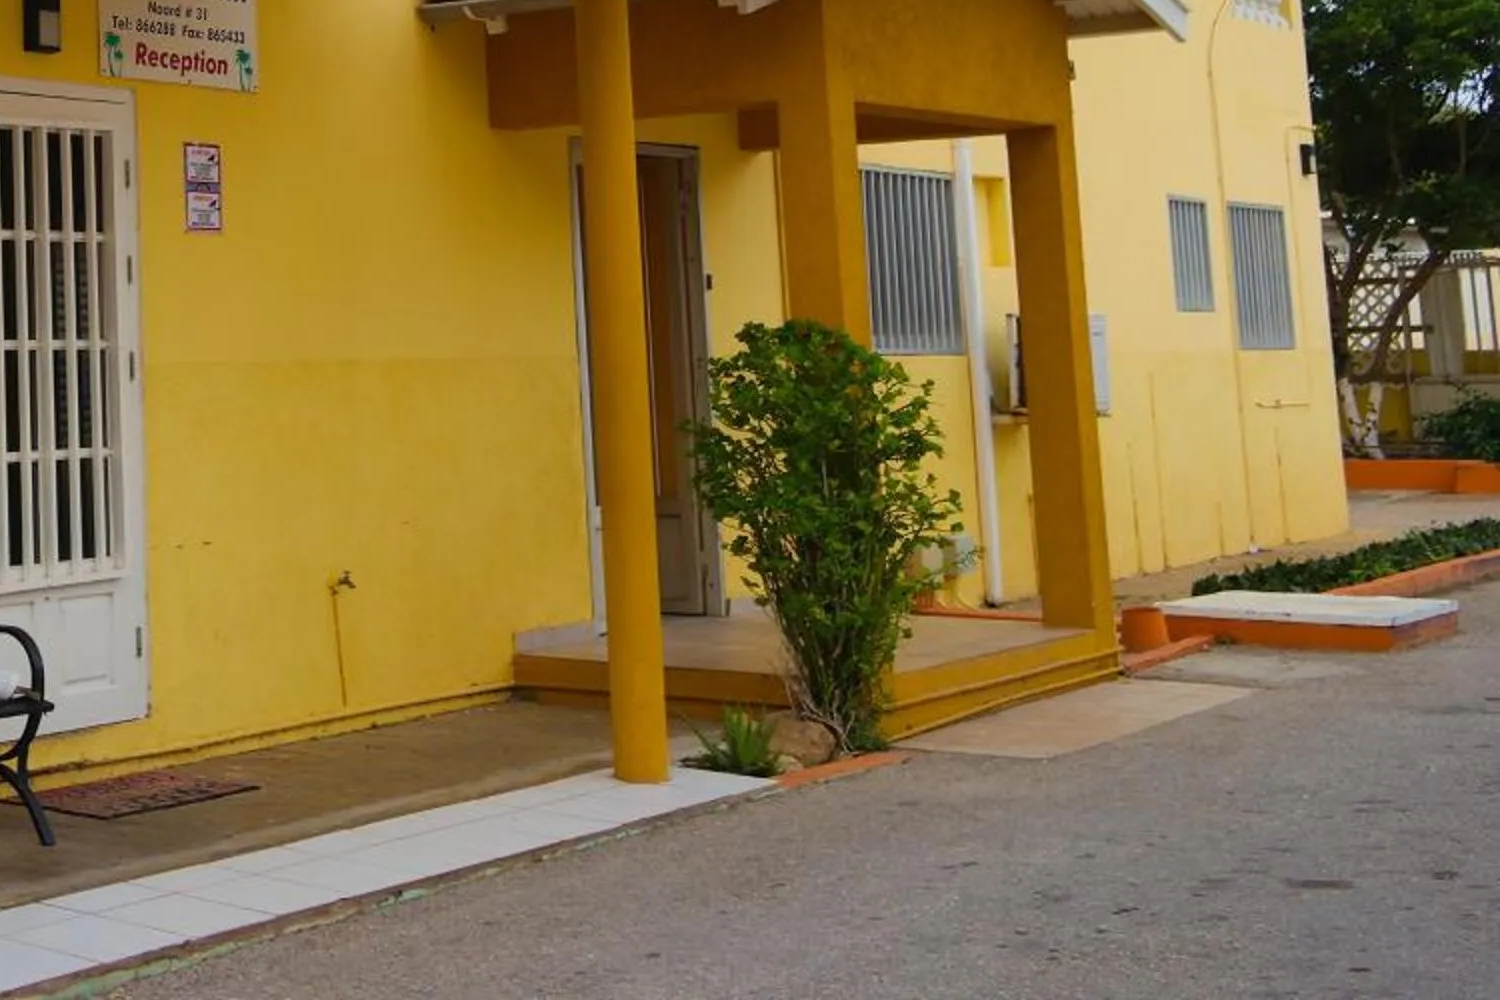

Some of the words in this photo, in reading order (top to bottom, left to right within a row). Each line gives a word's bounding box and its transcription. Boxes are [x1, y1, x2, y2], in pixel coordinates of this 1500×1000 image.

[147, 1, 181, 17] Noord
[195, 7, 207, 21] 31
[111, 15, 133, 30] Tel:
[181, 25, 205, 40] Fax:
[135, 41, 228, 77] Reception
